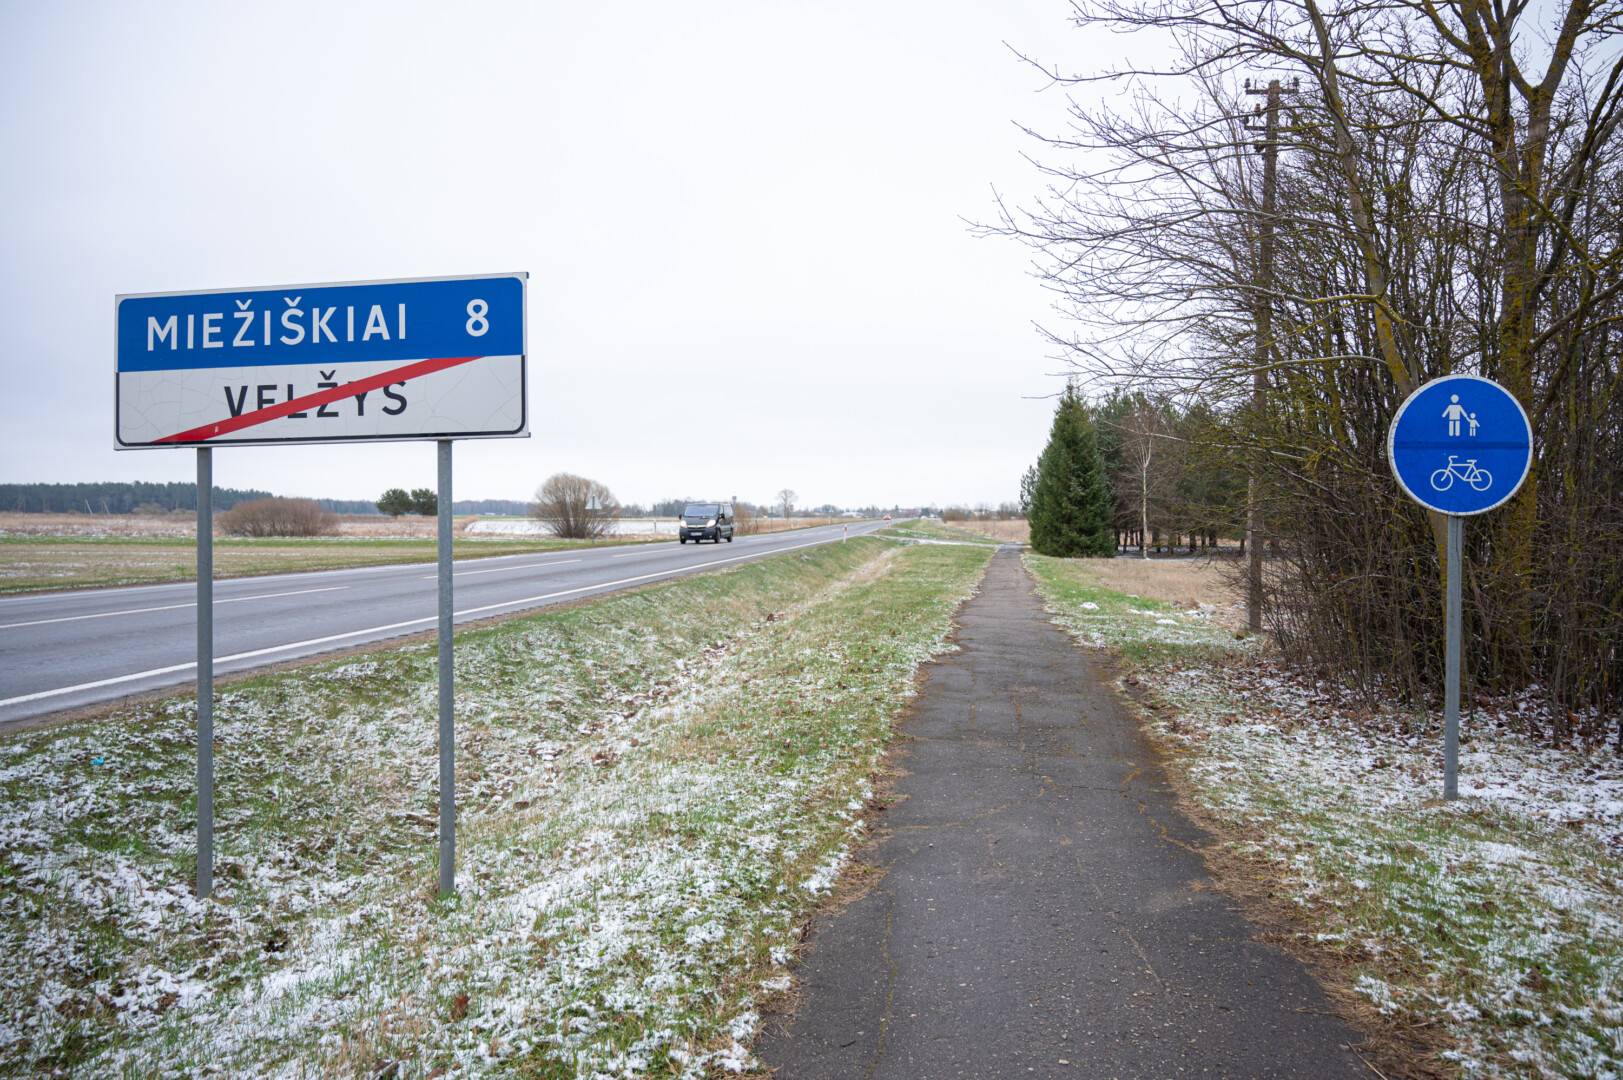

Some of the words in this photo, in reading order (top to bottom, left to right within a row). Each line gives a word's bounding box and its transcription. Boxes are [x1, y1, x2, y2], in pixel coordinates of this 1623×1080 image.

[147, 296, 406, 351] MIEŽIŠKIAI
[465, 298, 490, 337] 8
[224, 369, 408, 419] VELŽYS
